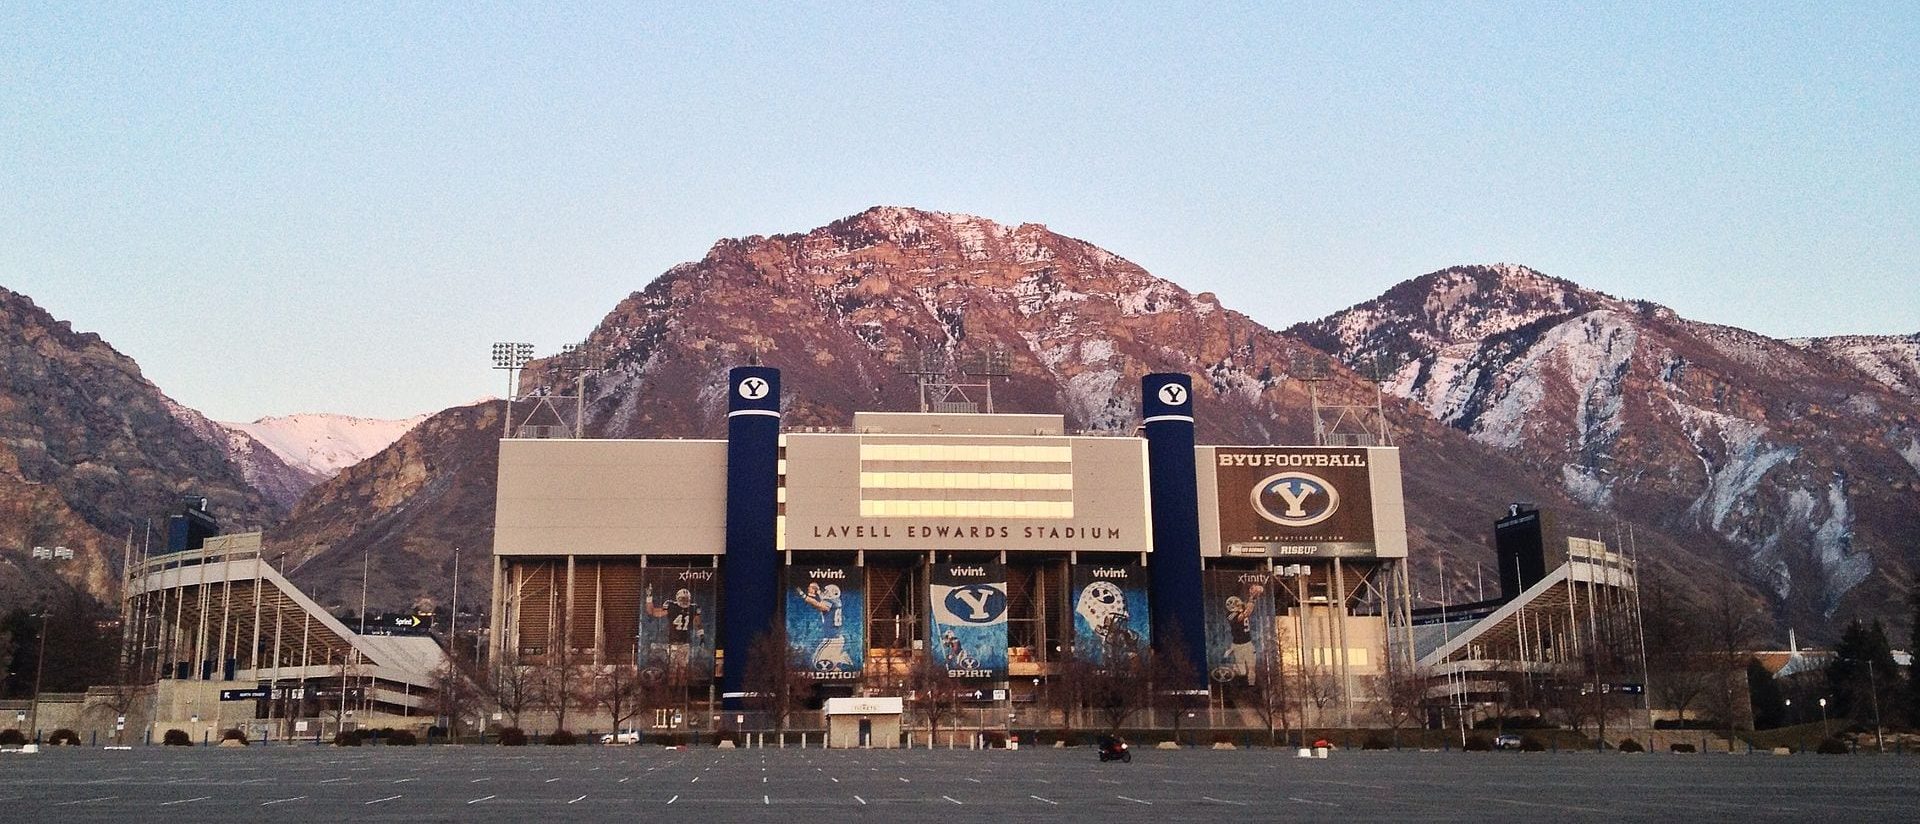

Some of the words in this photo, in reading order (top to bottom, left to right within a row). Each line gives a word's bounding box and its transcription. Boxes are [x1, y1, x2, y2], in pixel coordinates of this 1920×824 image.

[744, 380, 764, 396] Y
[1164, 386, 1183, 402] Y
[1219, 454, 1261, 466] BYU
[1264, 454, 1366, 467] FOOTBALL
[1270, 481, 1317, 517] Y
[814, 526, 891, 537] LAVELL
[908, 526, 1008, 538] EDWARDS
[1024, 526, 1120, 539] STADIUM
[679, 570, 713, 580] xfinity
[1238, 573, 1270, 584] xfinity
[954, 588, 994, 619] Y
[395, 618, 413, 626] Sprint
[673, 614, 690, 631] 41
[819, 660, 832, 671] Y
[964, 658, 976, 669] Y
[948, 669, 993, 678] SPIRIT
